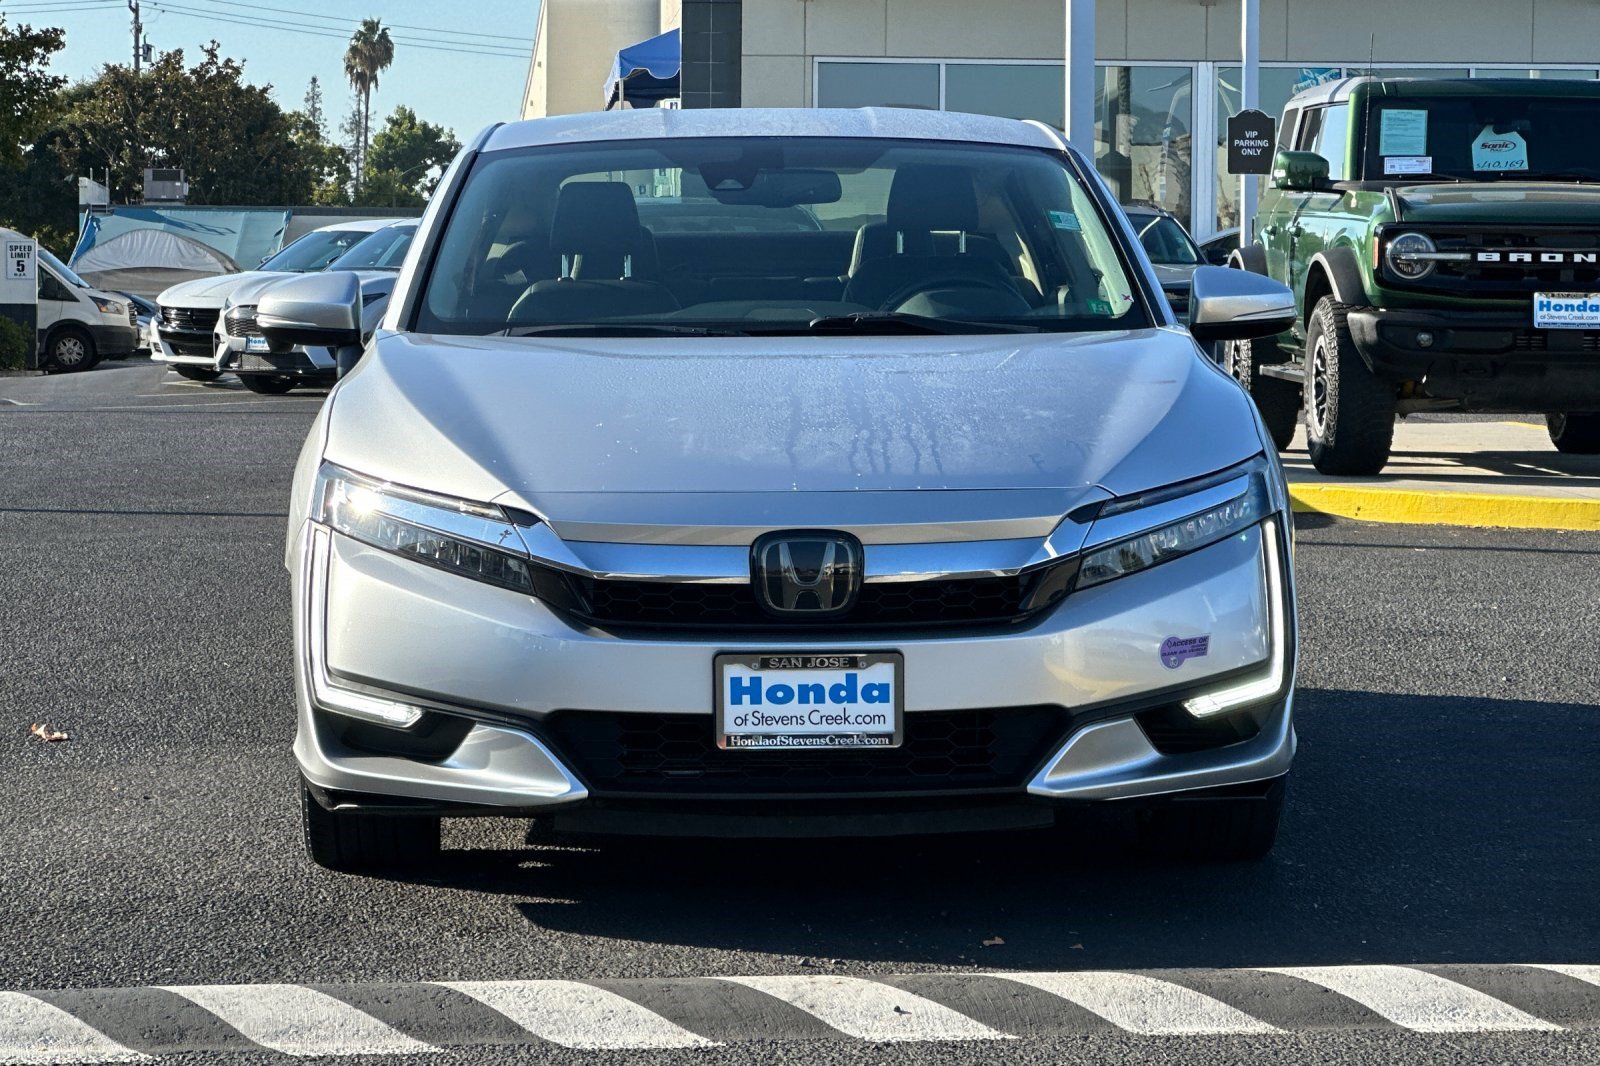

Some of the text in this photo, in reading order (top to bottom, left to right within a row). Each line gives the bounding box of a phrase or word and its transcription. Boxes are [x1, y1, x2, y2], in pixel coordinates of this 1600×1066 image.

[1245, 130, 1258, 138] VIP
[1234, 139, 1269, 147] PARKING
[1480, 141, 1512, 150] Sonic
[1241, 148, 1262, 156] ONLY
[16, 259, 25, 272] 5
[1538, 300, 1600, 313] Honda
[1172, 639, 1197, 647] ACCESS
[768, 656, 850, 668] SAN JOSE
[729, 672, 891, 706] Honda
[733, 707, 887, 727] of Stevens Creek.com
[730, 735, 890, 747] HondaofStevensCreek.com
